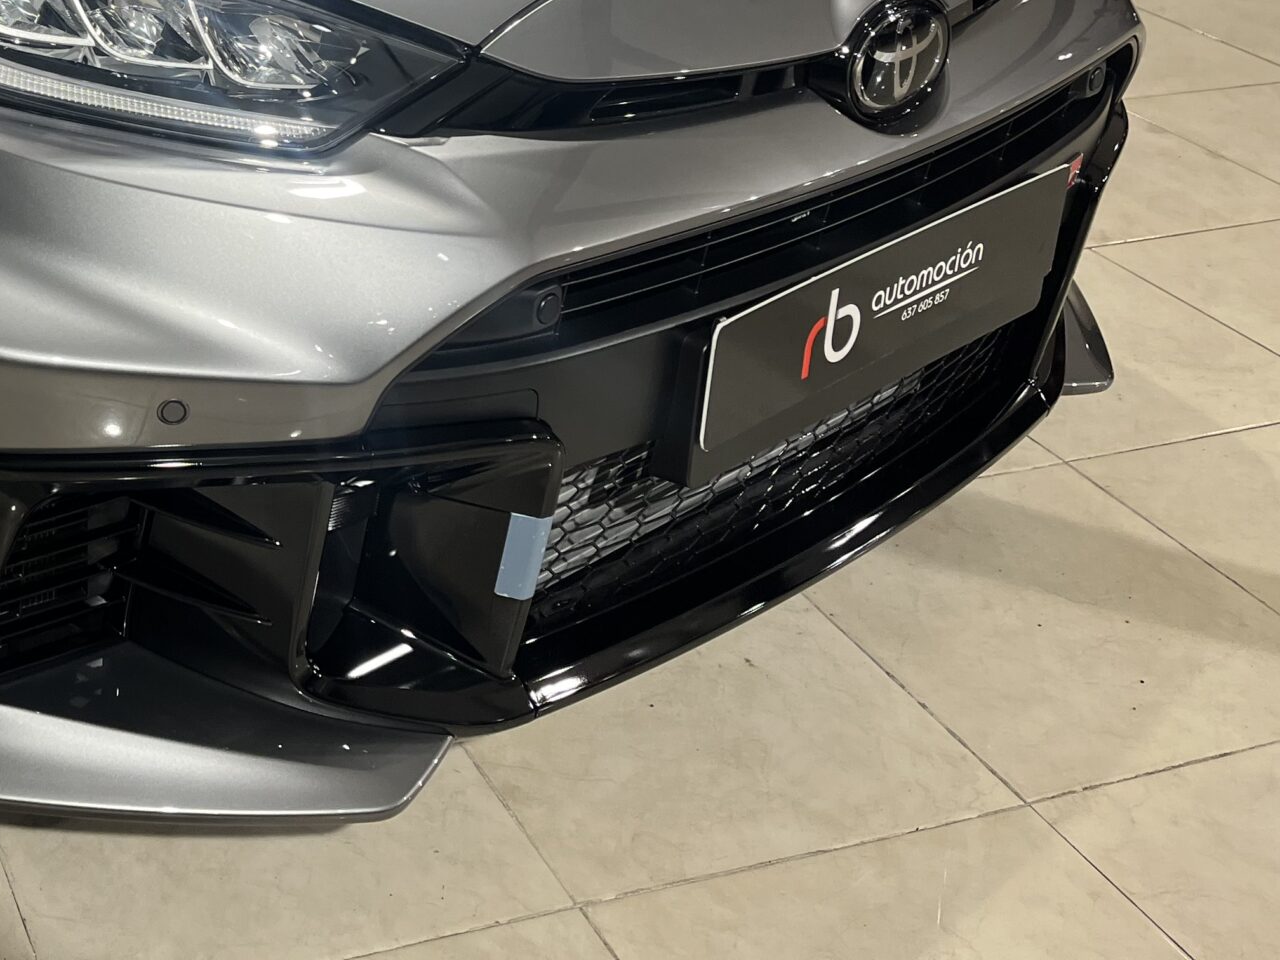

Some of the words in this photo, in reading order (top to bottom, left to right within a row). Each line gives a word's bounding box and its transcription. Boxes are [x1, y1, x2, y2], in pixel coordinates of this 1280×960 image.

[871, 240, 985, 312] automoción
[901, 304, 918, 321] 637
[917, 296, 934, 313] 605
[934, 288, 950, 305] 857
[800, 287, 862, 381] rb
